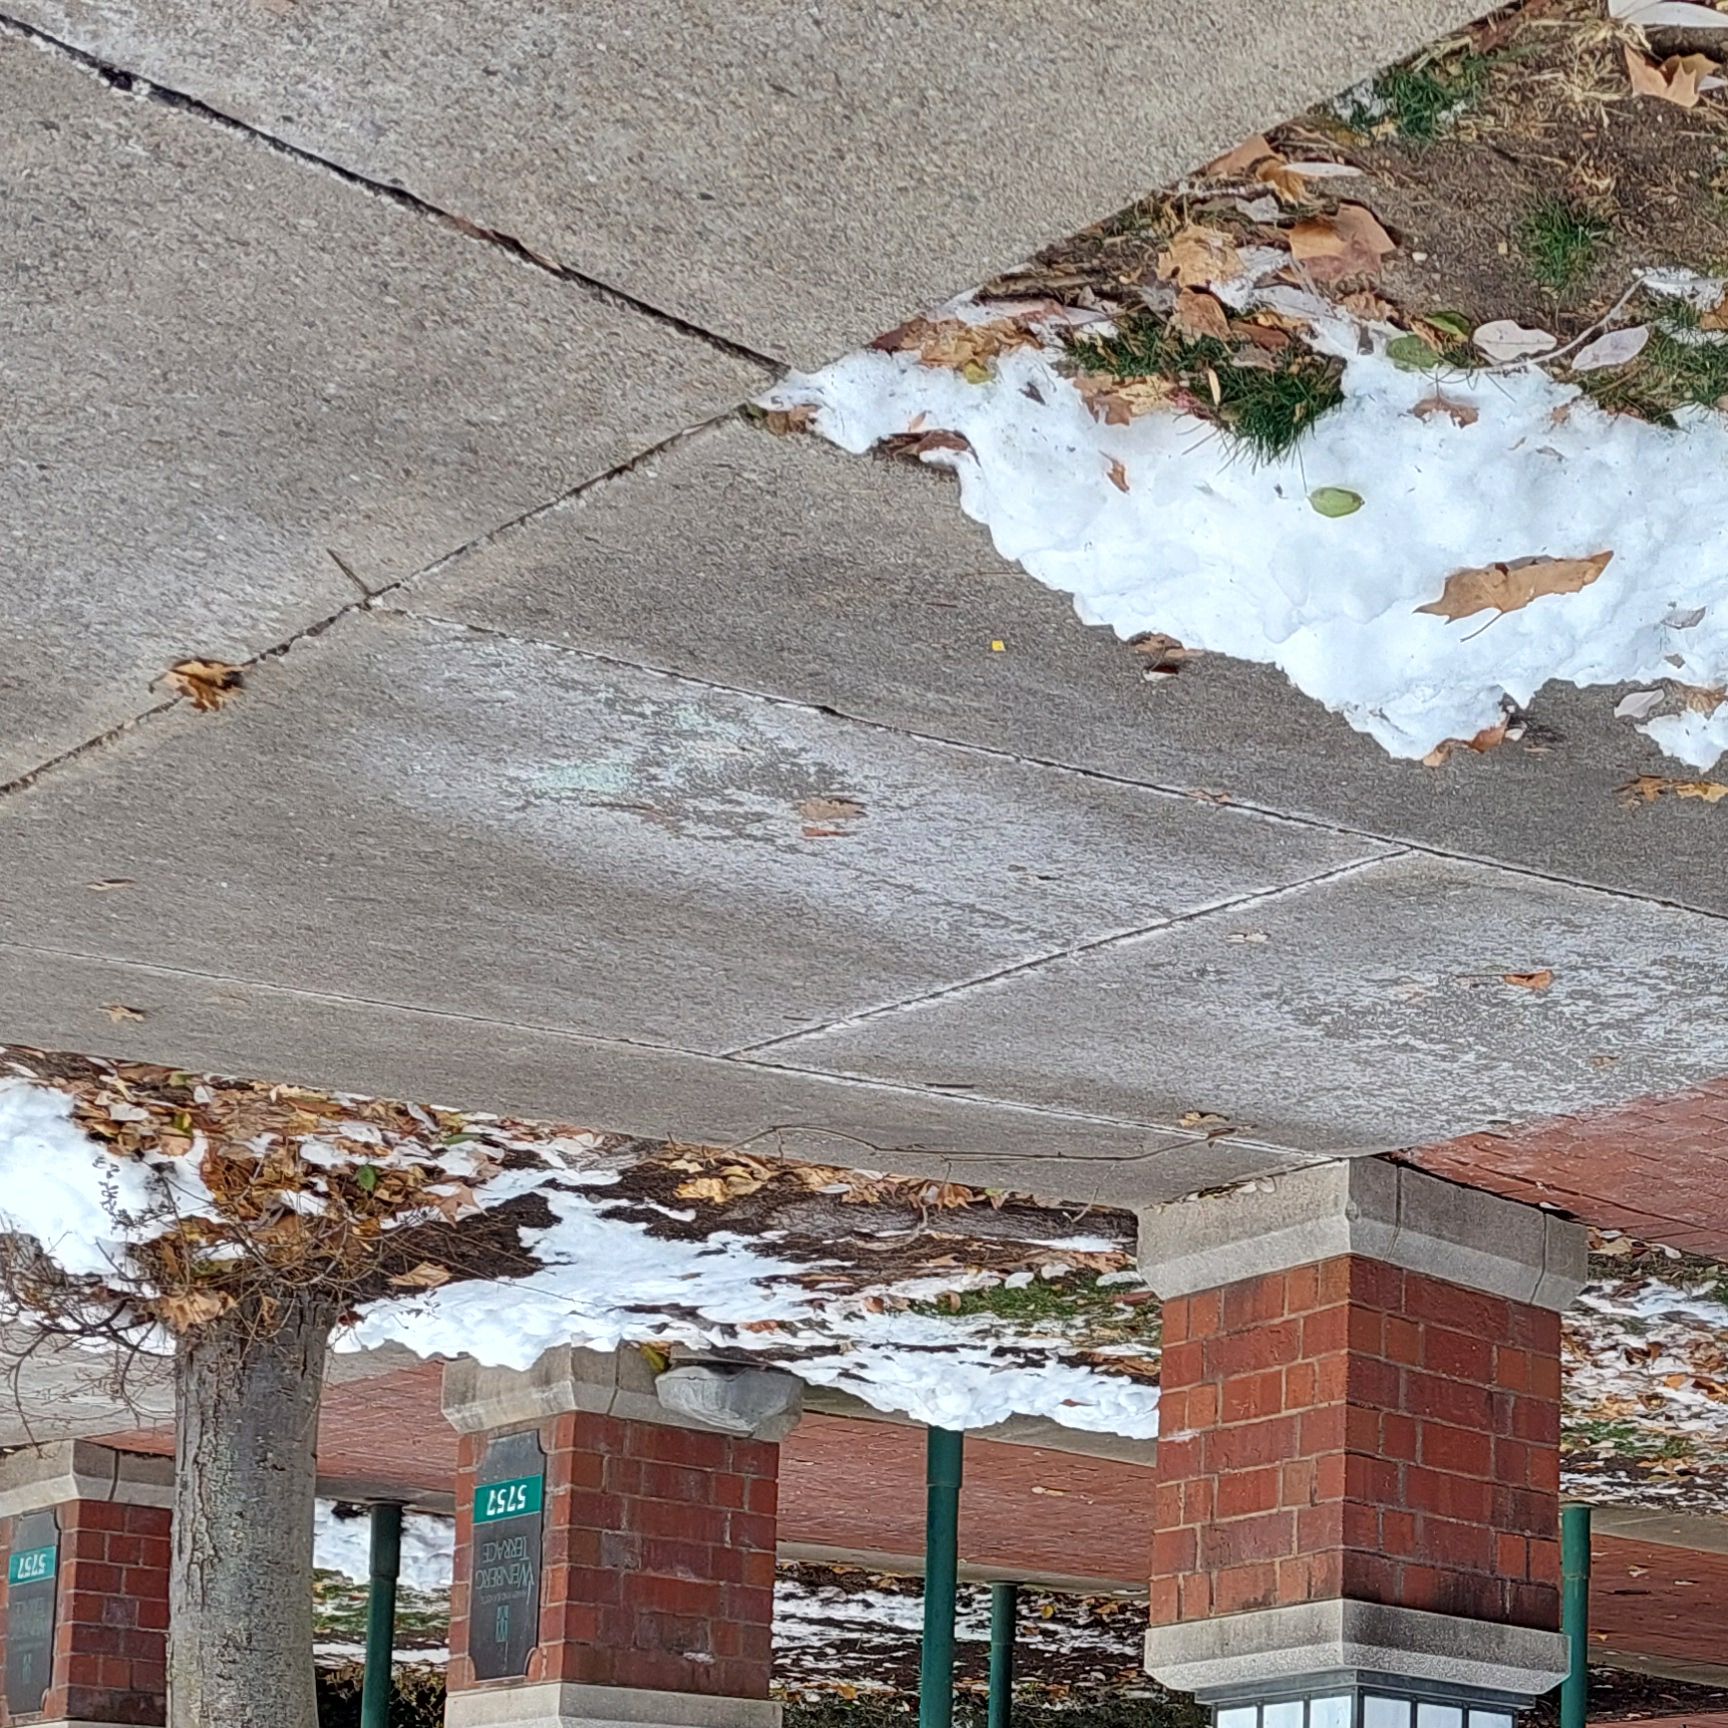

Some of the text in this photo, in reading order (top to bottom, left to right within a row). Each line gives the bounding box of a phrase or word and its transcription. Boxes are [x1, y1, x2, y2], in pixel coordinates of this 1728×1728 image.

[486, 1484, 528, 1516] 5757
[481, 1535, 530, 1564] TERRACE
[17, 1553, 47, 1580] 5757
[474, 1561, 535, 1591] WEINBERG
